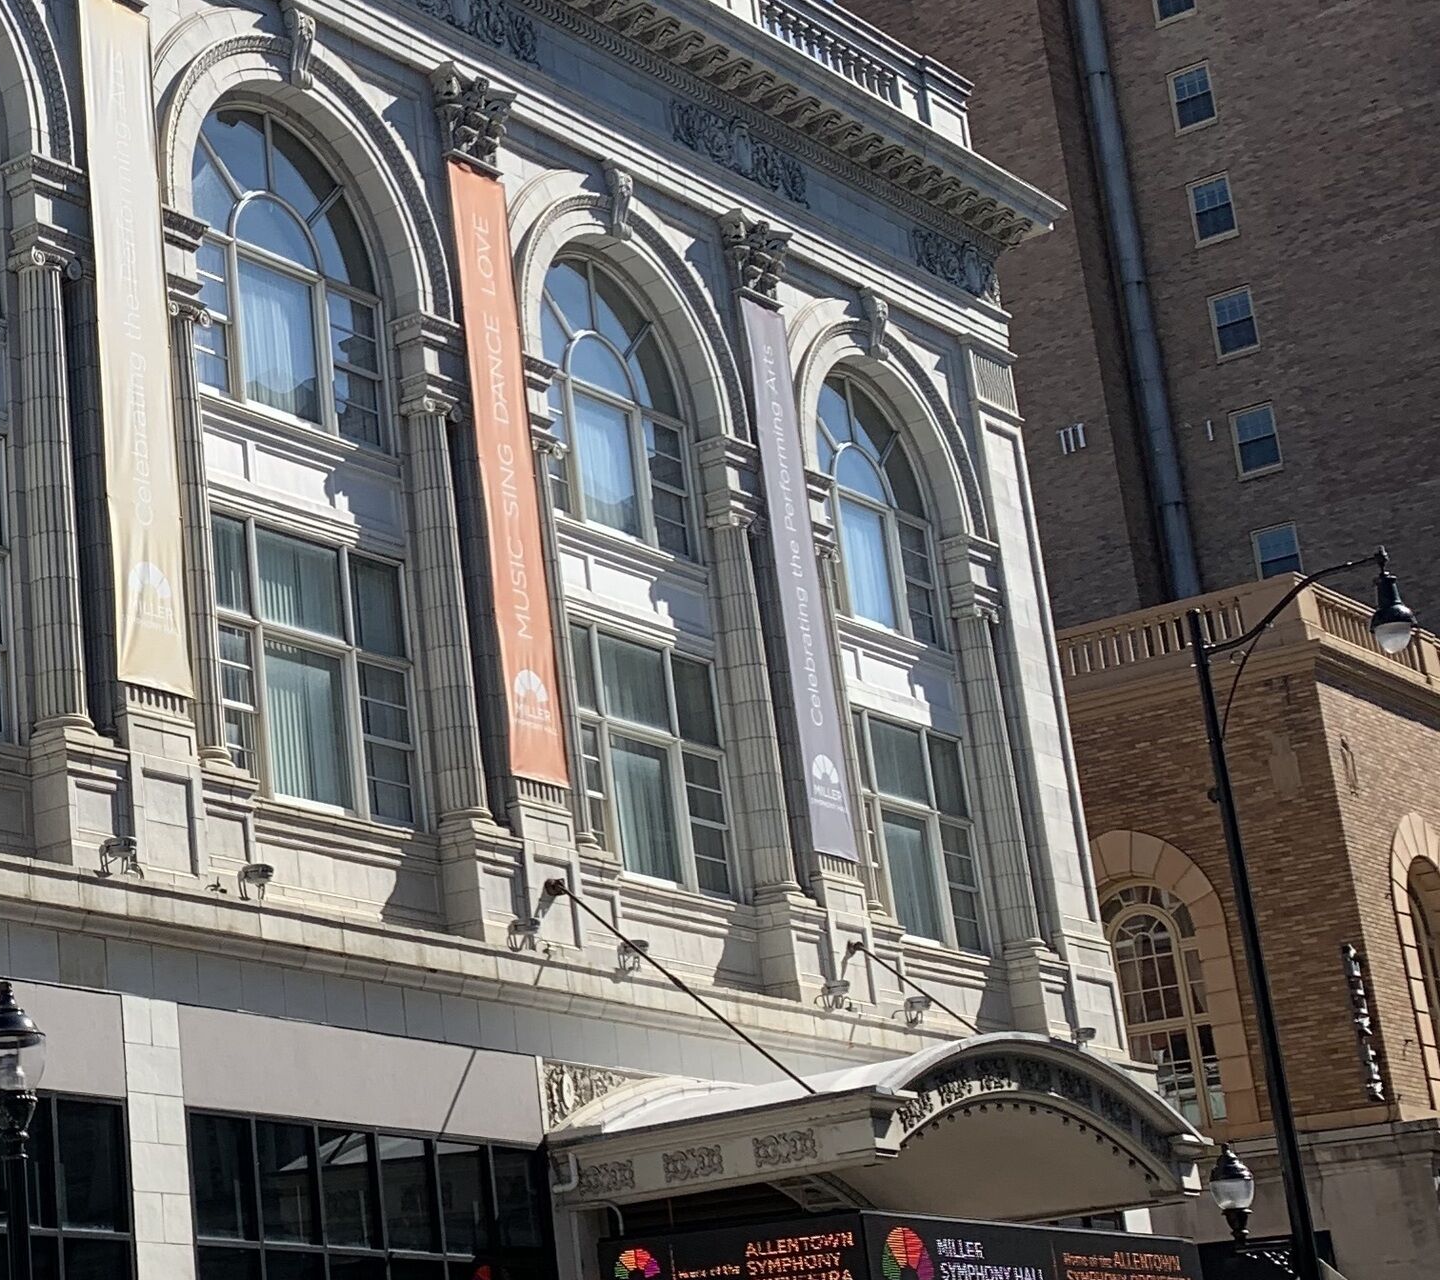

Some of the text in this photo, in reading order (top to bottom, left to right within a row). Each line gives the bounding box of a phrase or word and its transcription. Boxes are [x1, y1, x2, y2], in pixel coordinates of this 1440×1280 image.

[472, 213, 533, 640] MUSIC SING DANCE LOVE
[762, 345, 824, 727] Celebrating the Performing Arts
[744, 1231, 855, 1257] ALLENTOWN
[935, 1238, 985, 1259] MILLER
[746, 1252, 841, 1276] SYMPHONY
[1113, 1251, 1181, 1273] ALLENTOWN
